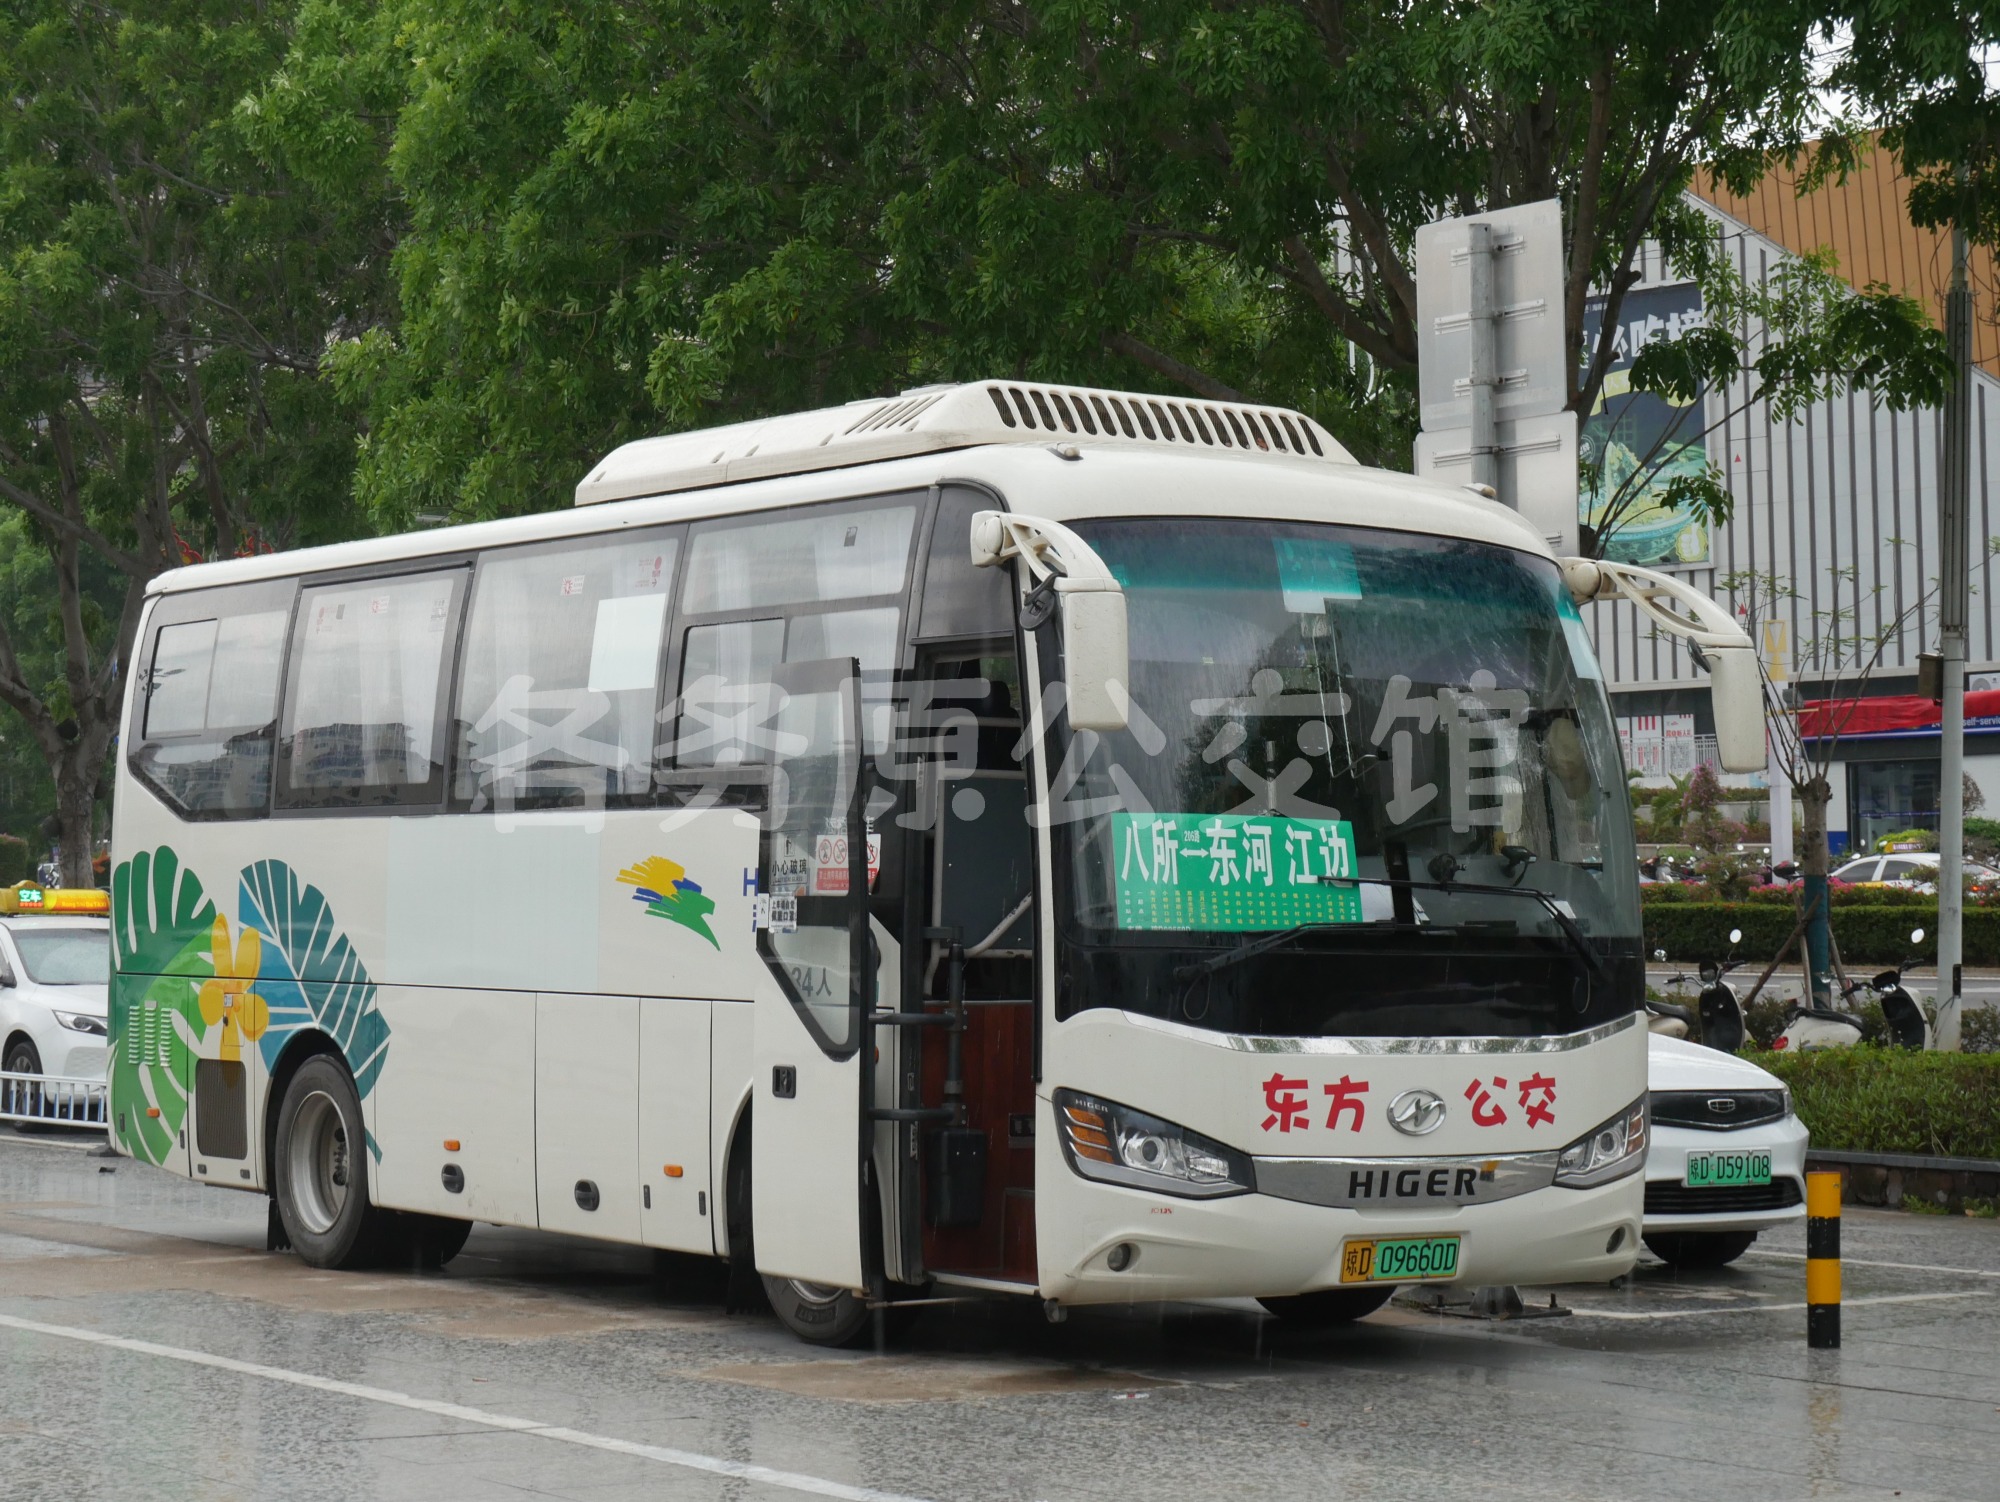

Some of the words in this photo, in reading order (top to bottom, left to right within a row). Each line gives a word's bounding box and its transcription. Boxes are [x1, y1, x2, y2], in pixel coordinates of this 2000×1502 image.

[772, 858, 807, 877] 小心玻璃
[1121, 819, 1179, 885] 八所
[1205, 818, 1274, 887] 东河
[1284, 824, 1350, 888] 江边
[19, 889, 42, 902] 空车
[1261, 1072, 1369, 1133] 东方
[1464, 1072, 1557, 1129] 公交
[1348, 1168, 1477, 1199] HIGER
